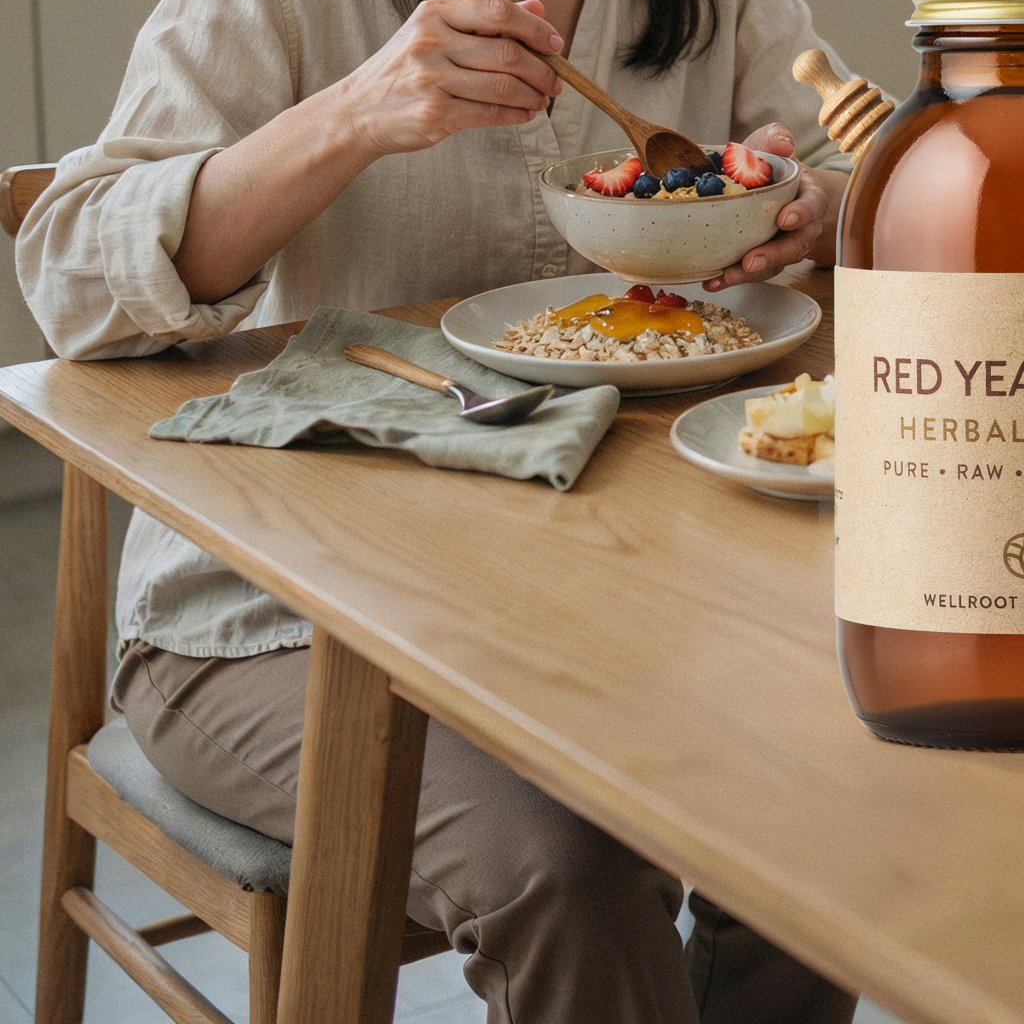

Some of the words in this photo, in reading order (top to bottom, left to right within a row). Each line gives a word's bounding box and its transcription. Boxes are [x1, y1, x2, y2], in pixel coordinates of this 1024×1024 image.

[873, 356, 942, 395] RED
[900, 416, 1024, 443] HERBAL
[883, 459, 930, 478] PURE
[957, 464, 1004, 480] RAW
[923, 593, 1018, 610] WELLROOT
